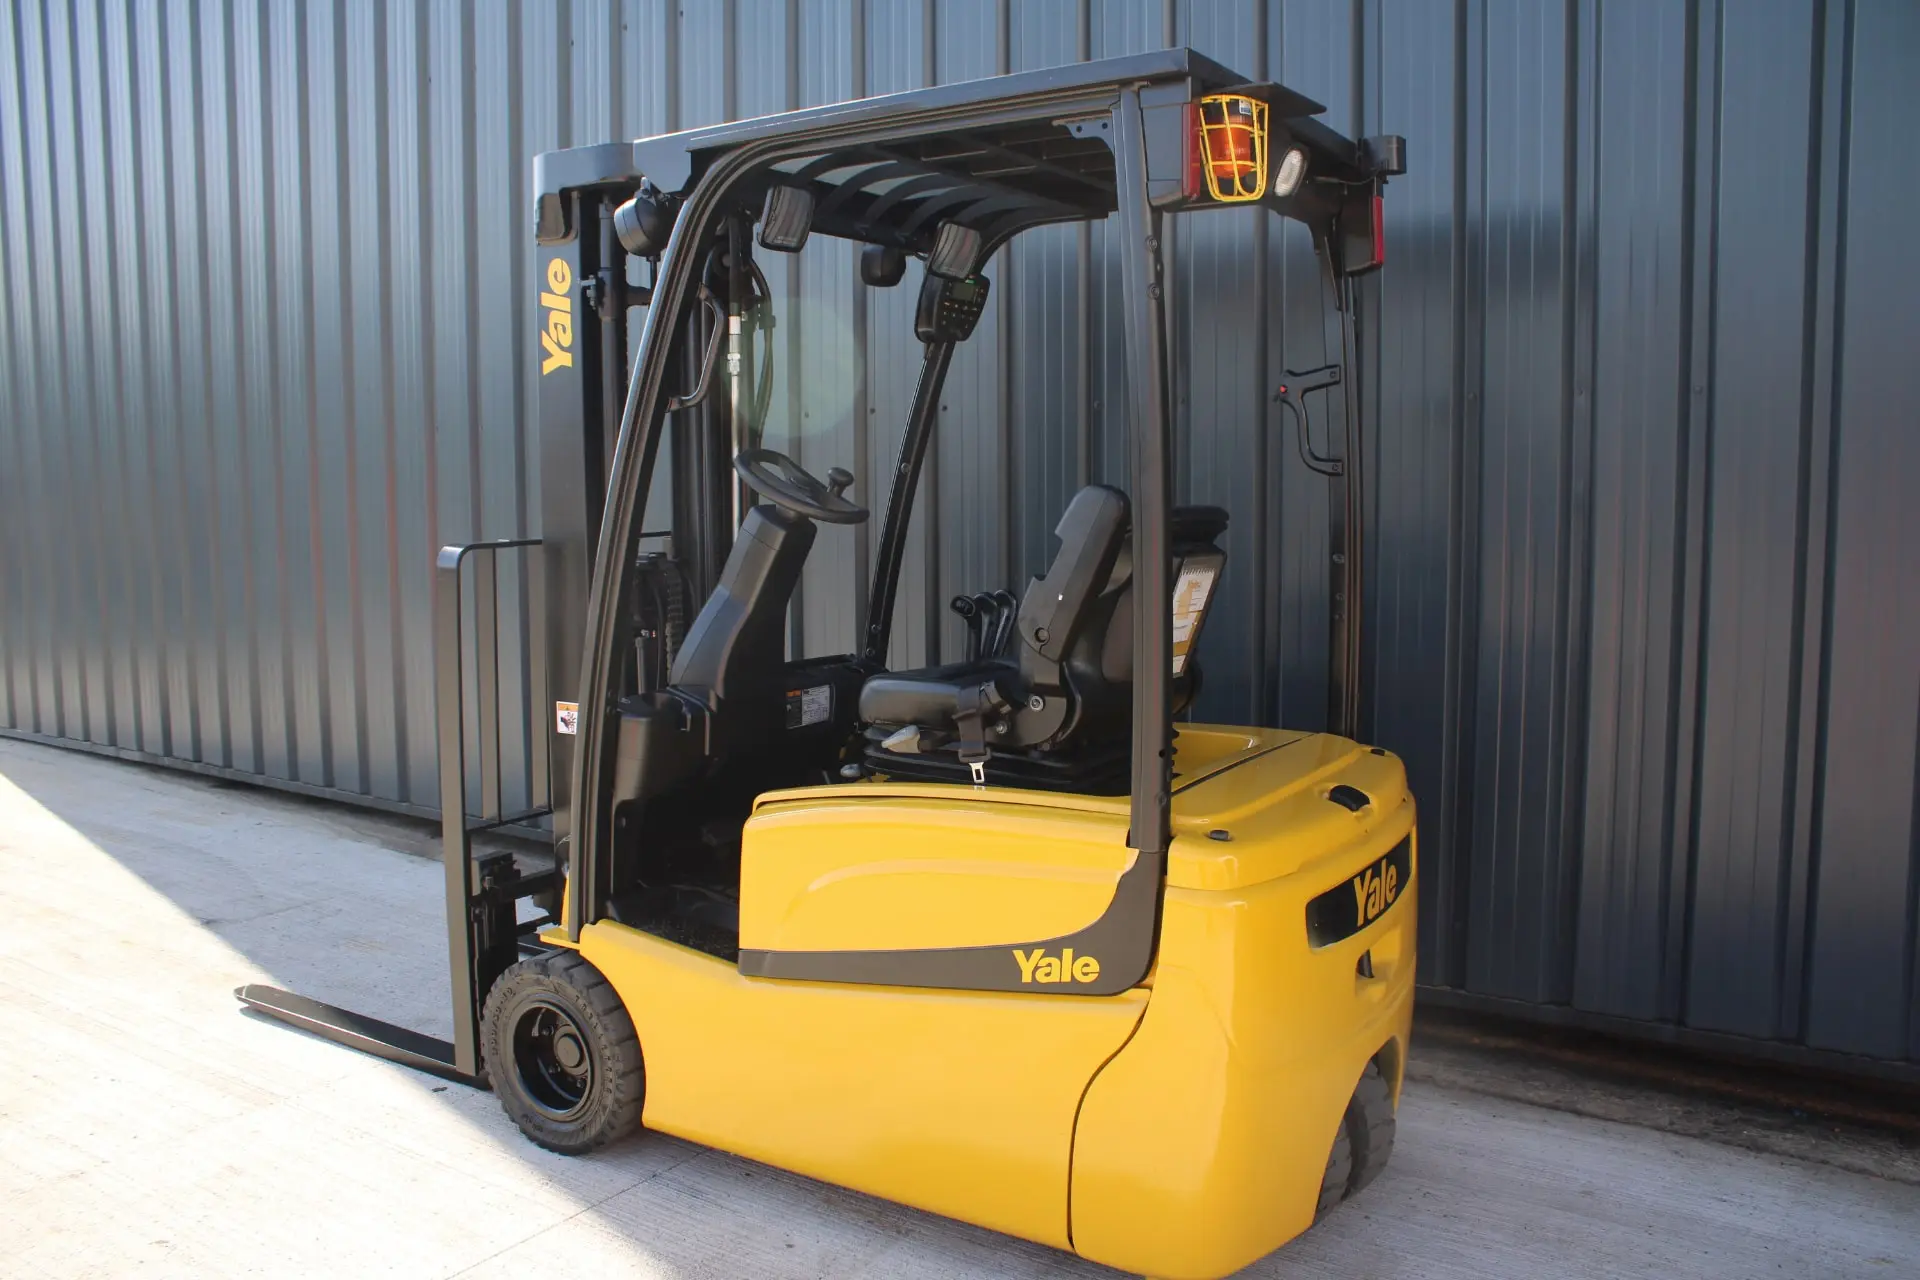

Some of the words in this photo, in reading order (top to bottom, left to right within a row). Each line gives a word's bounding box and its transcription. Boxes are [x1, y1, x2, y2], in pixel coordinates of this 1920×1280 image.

[540, 257, 573, 376] Yale
[1353, 857, 1397, 927] Yale
[1012, 948, 1100, 983] Yale
